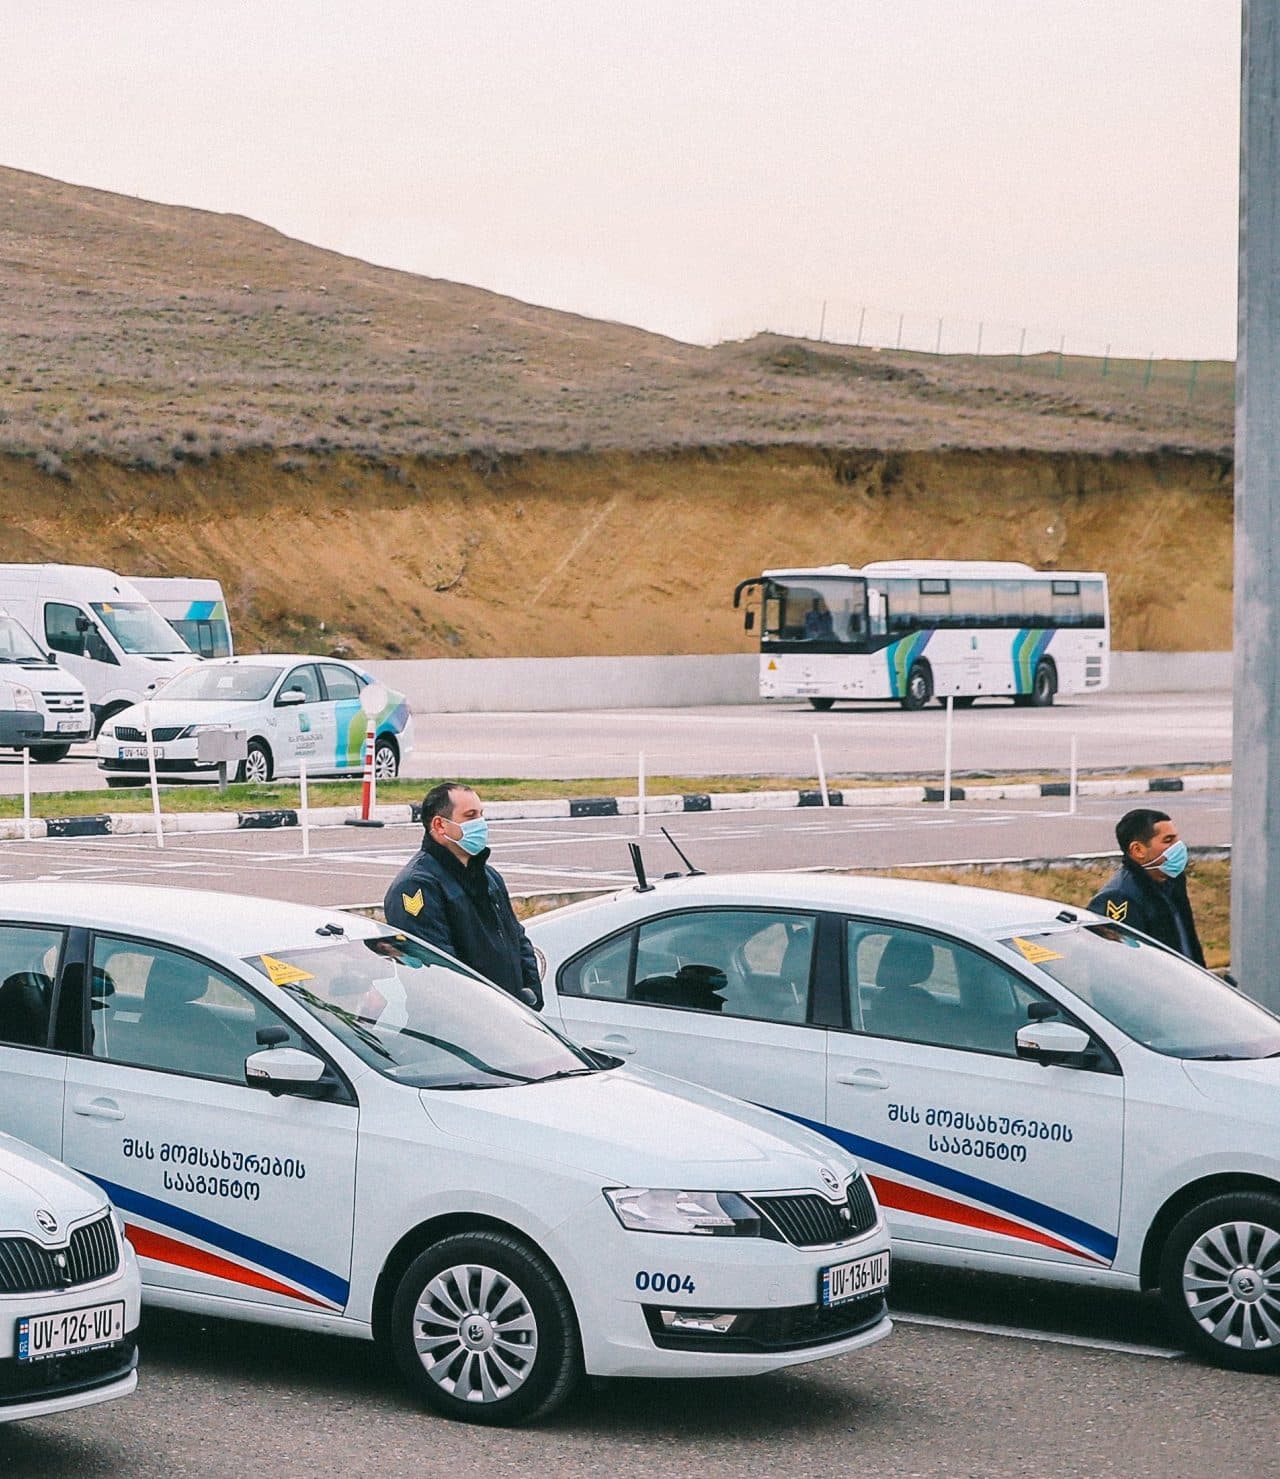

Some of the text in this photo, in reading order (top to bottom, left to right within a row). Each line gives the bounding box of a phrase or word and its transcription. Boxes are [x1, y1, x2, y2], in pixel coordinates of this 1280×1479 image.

[888, 1104, 1073, 1143] შსს მომსახურების
[123, 1138, 306, 1180] შსს მომსახურების
[928, 1134, 1027, 1163] სააგენტო
[163, 1170, 260, 1201] სააგენტო
[635, 1270, 696, 1294] 0004
[832, 1257, 883, 1297] UV-136-VU
[33, 1309, 113, 1350] UV-126-VU
